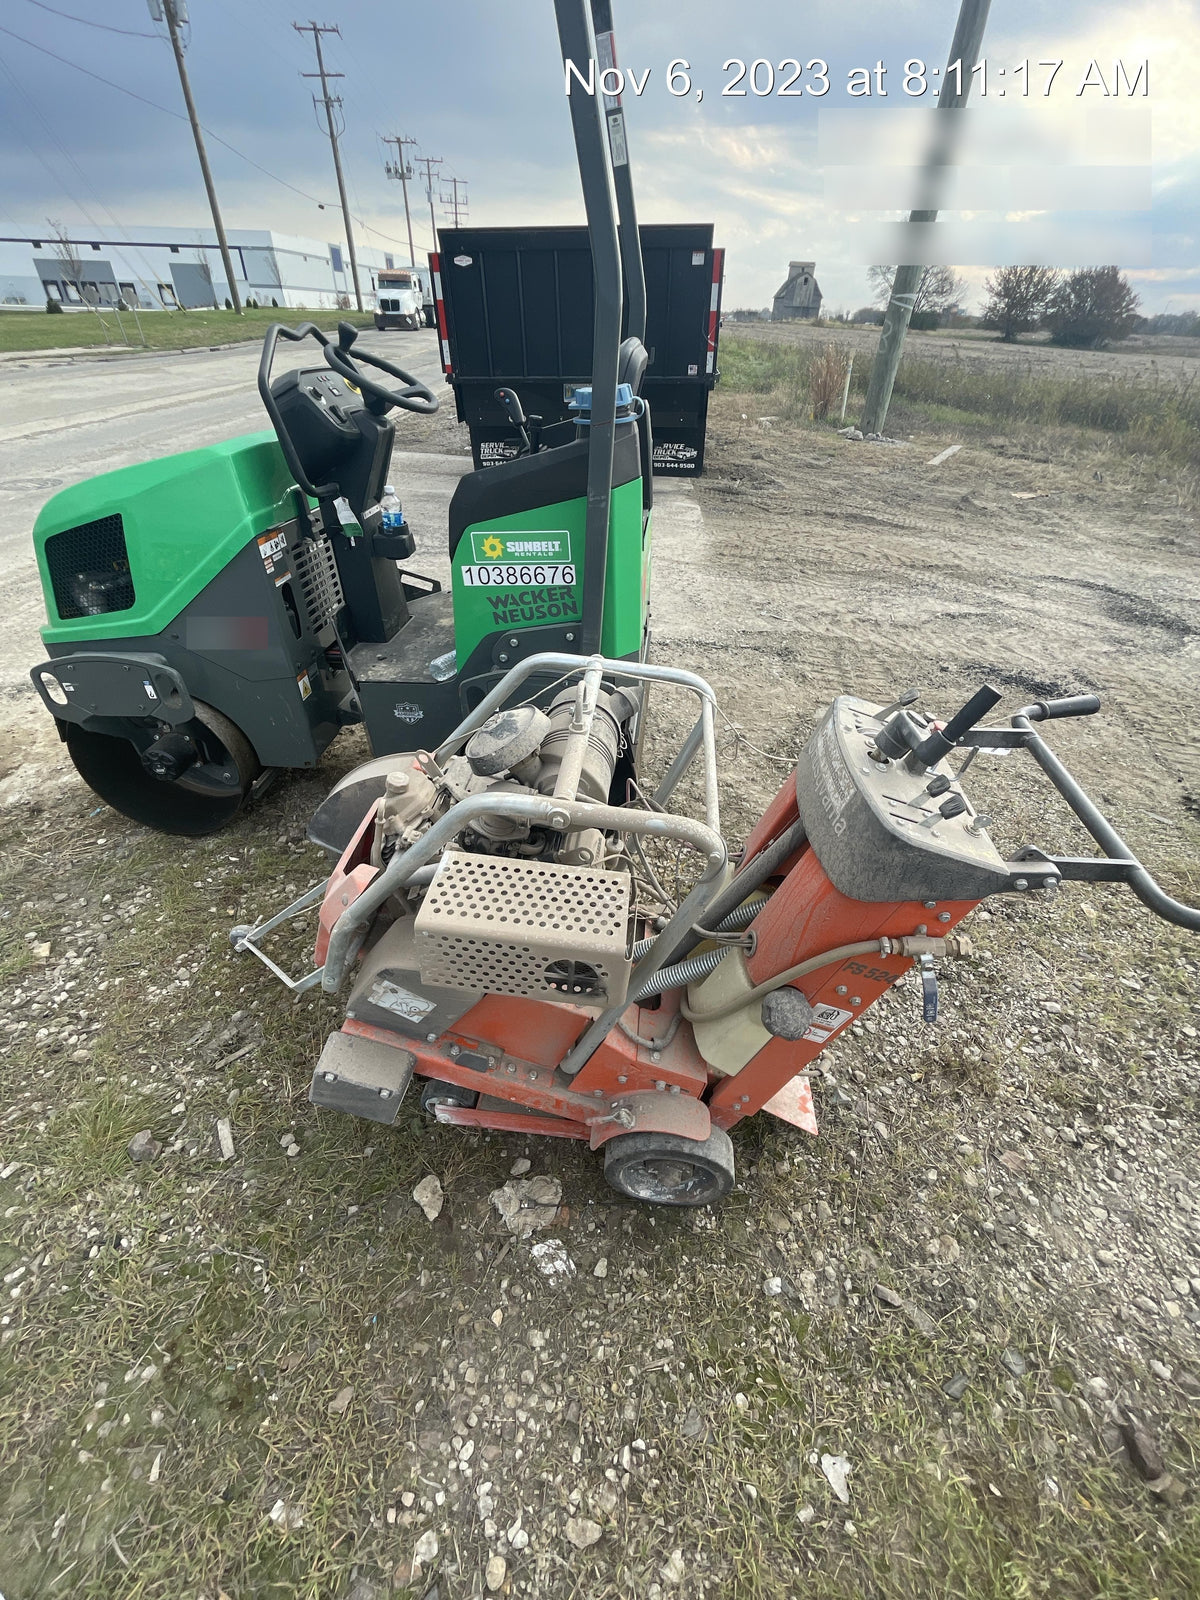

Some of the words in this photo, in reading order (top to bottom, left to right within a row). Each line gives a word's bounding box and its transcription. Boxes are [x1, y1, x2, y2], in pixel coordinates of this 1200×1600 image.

[506, 541, 561, 553] SUNBELT
[465, 566, 575, 585] 10386676
[486, 585, 575, 610] WACKER
[491, 600, 579, 626] NEUSON
[841, 961, 869, 975] FS
[863, 967, 900, 985] 524
